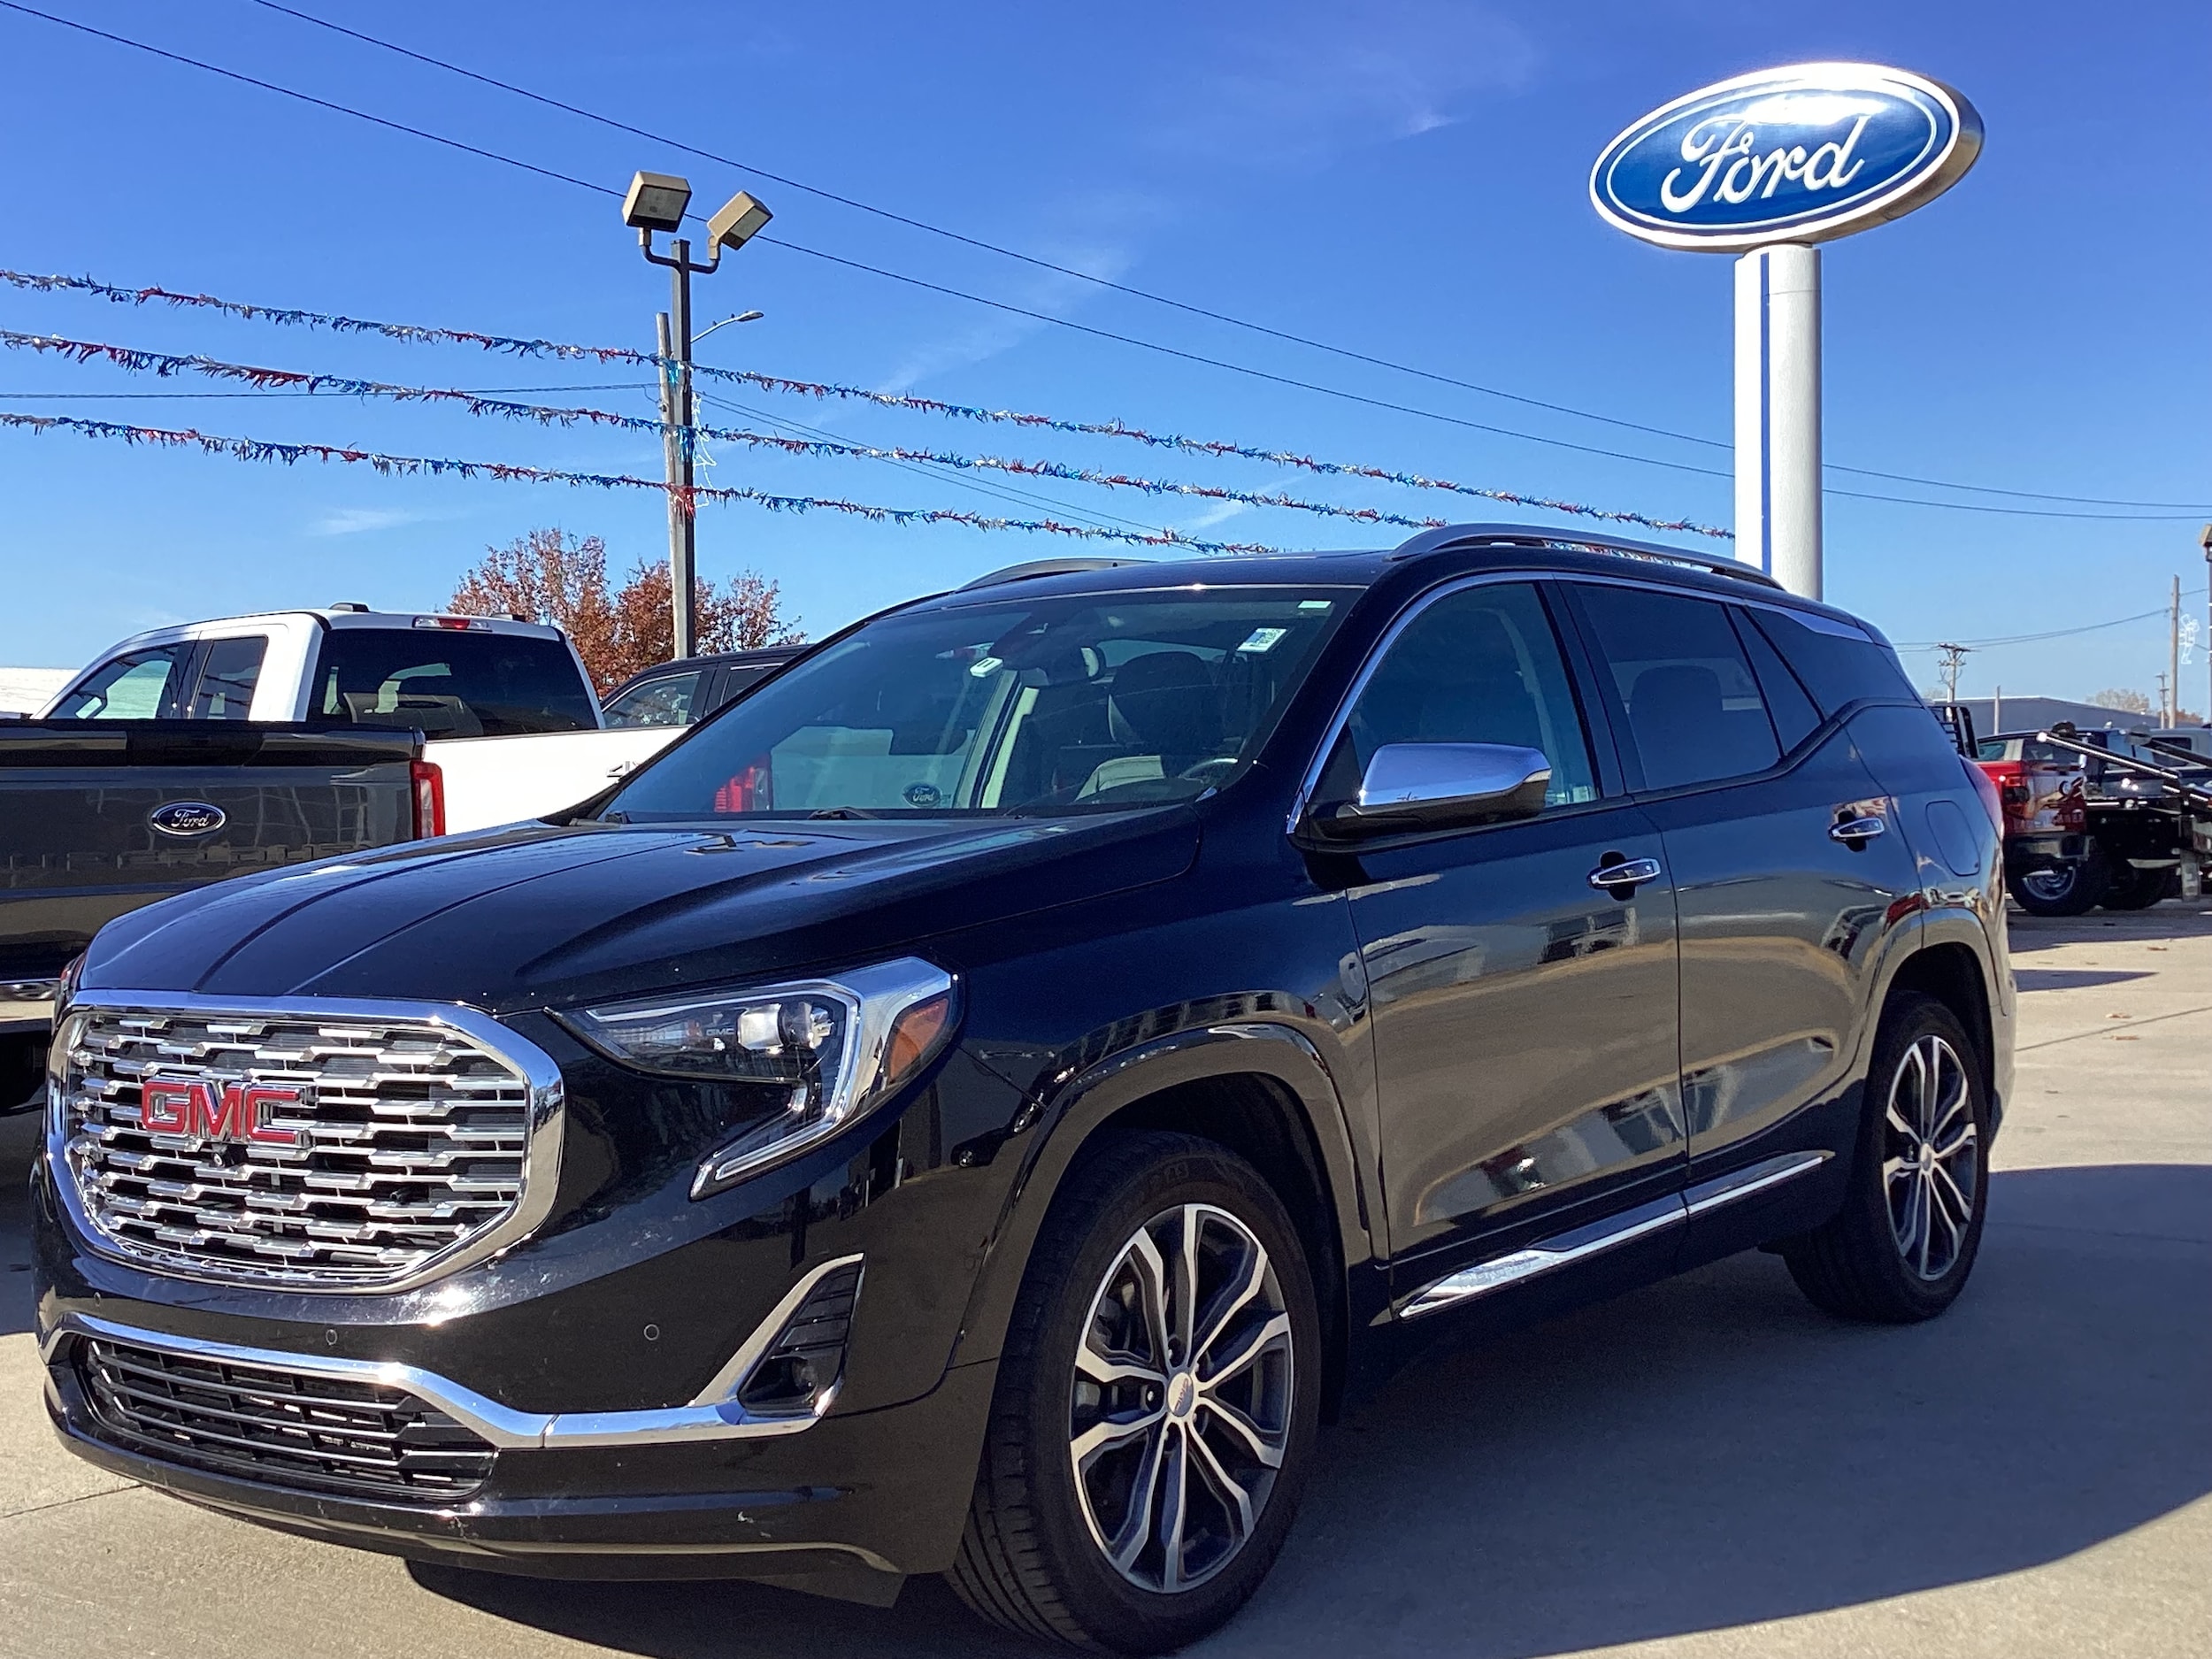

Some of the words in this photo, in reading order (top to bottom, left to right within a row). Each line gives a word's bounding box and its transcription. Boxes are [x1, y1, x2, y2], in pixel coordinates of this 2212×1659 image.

[1661, 113, 1872, 213] Ford
[912, 787, 936, 803] Ford
[171, 809, 211, 827] Ford
[706, 1027, 735, 1036] GMC
[142, 1077, 305, 1146] GMC
